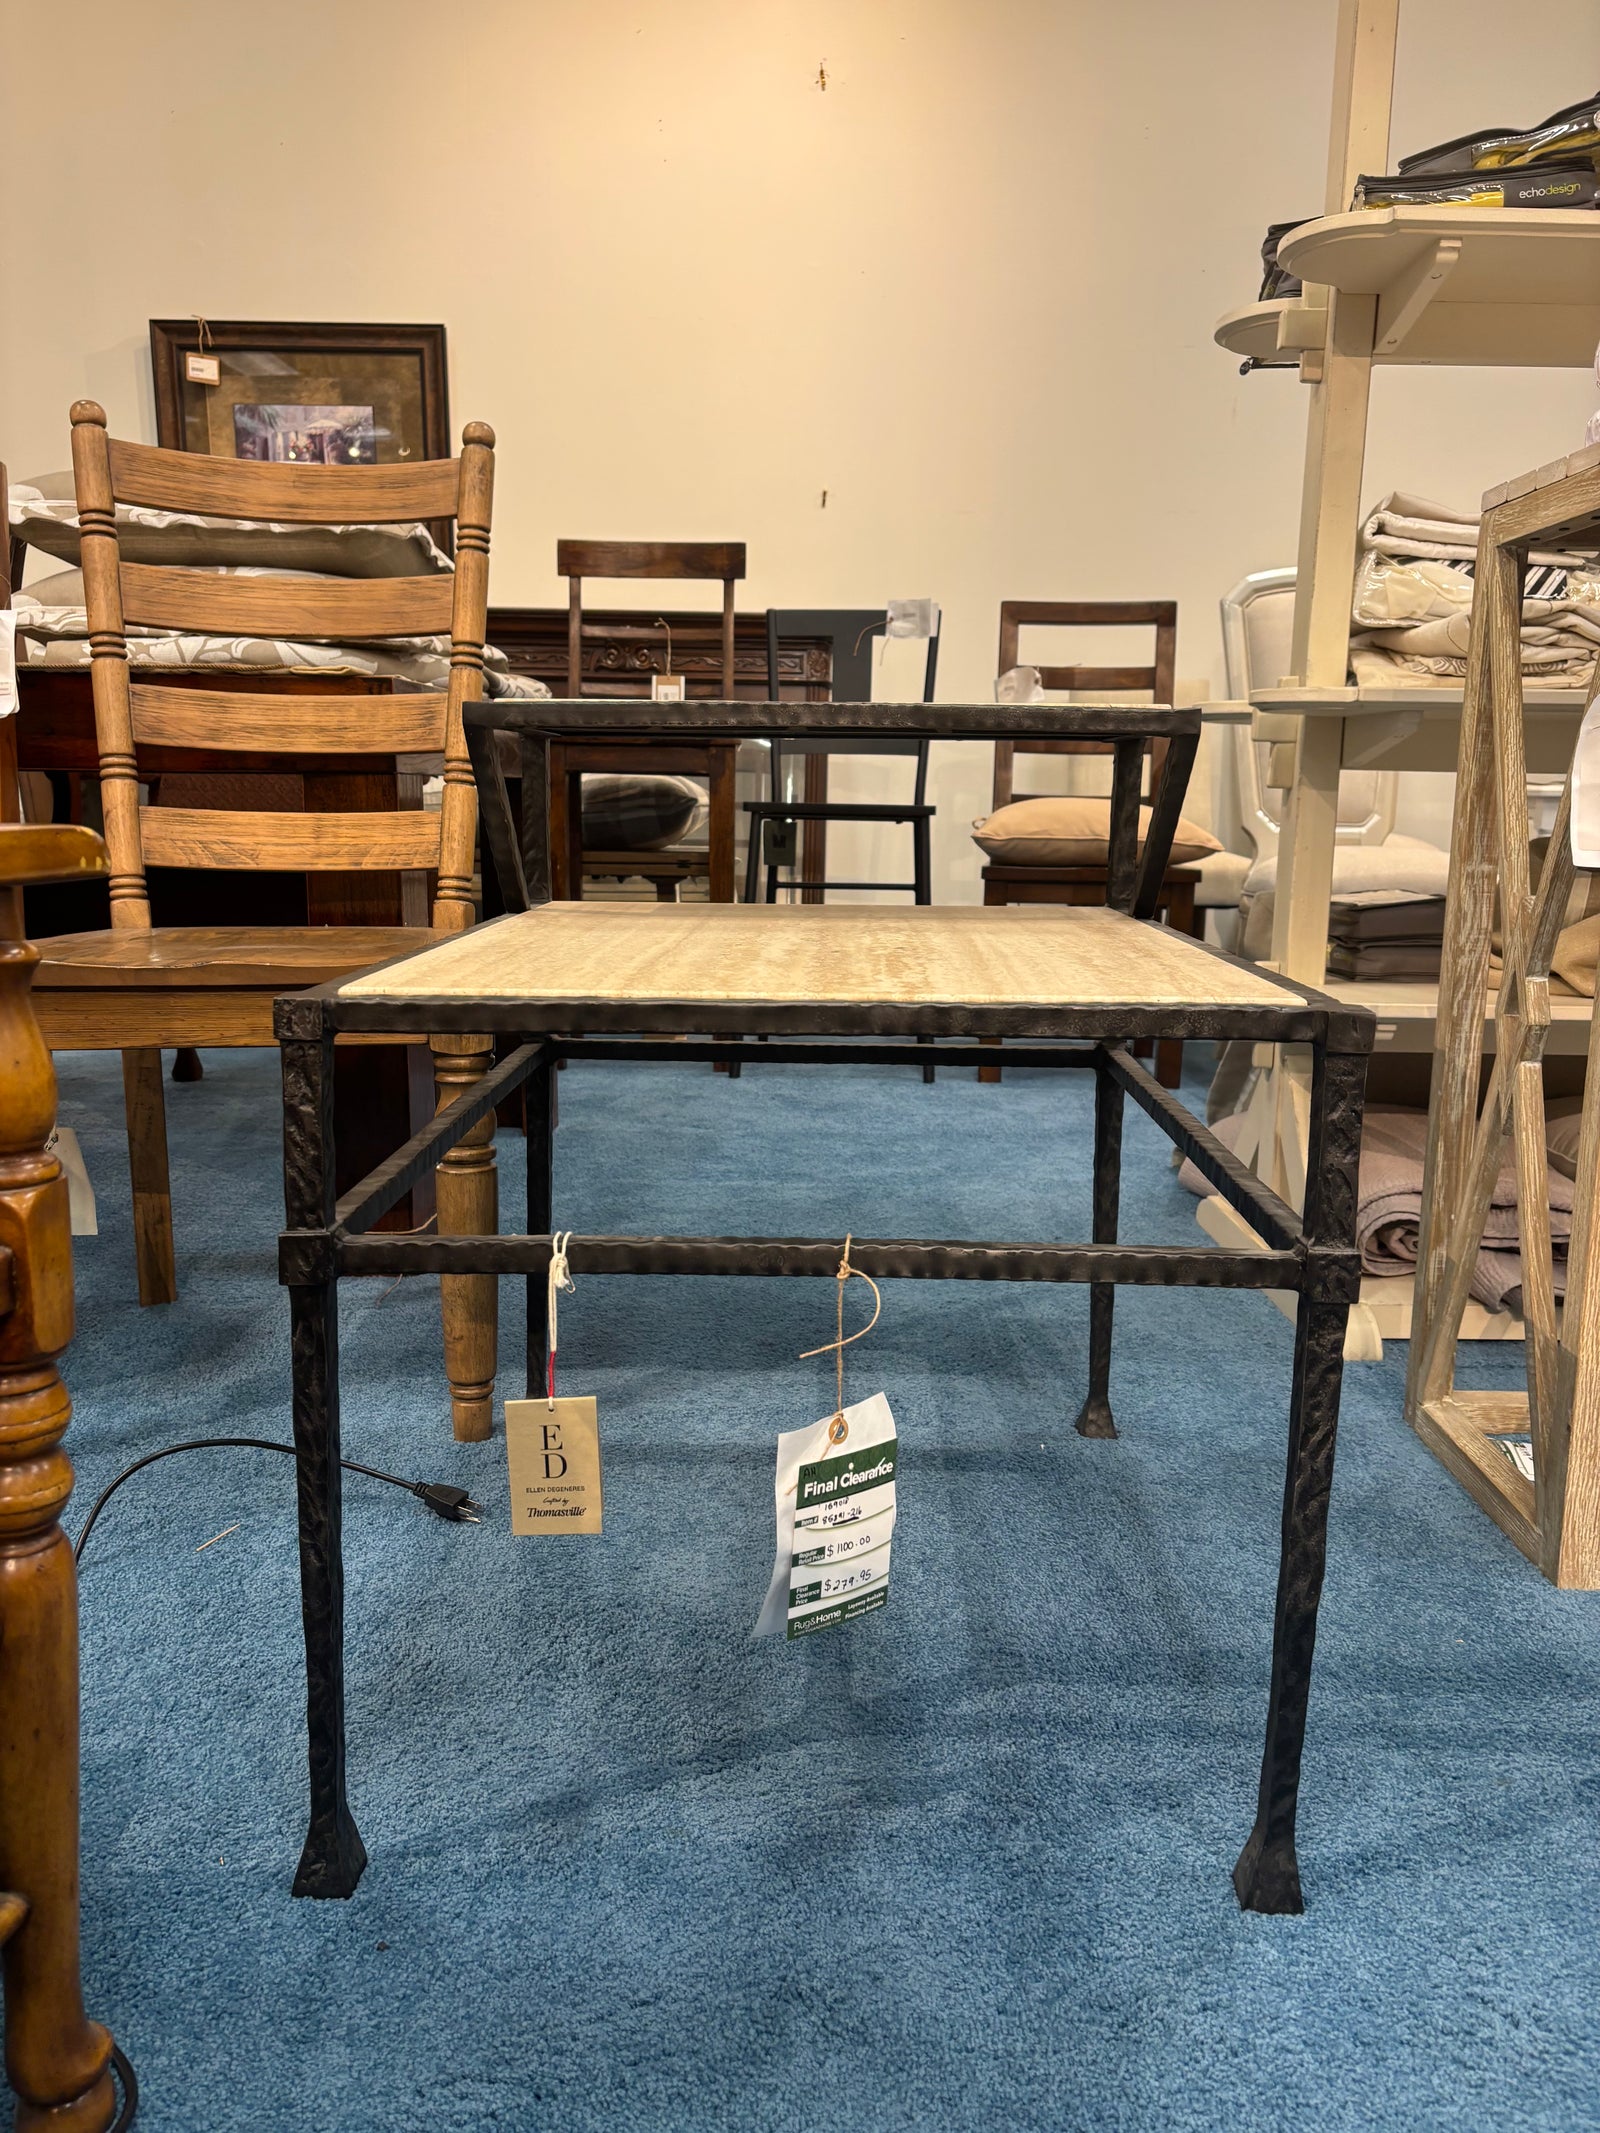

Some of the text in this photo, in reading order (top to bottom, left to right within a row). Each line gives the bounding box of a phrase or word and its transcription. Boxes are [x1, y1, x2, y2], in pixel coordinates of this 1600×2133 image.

[1519, 183, 1580, 199] echodesign
[539, 1424, 563, 1451] E
[541, 1453, 568, 1479] D
[547, 1485, 585, 1493] DEGENERES
[804, 1461, 894, 1498] Final Clearance
[527, 1506, 586, 1518] Thomasville
